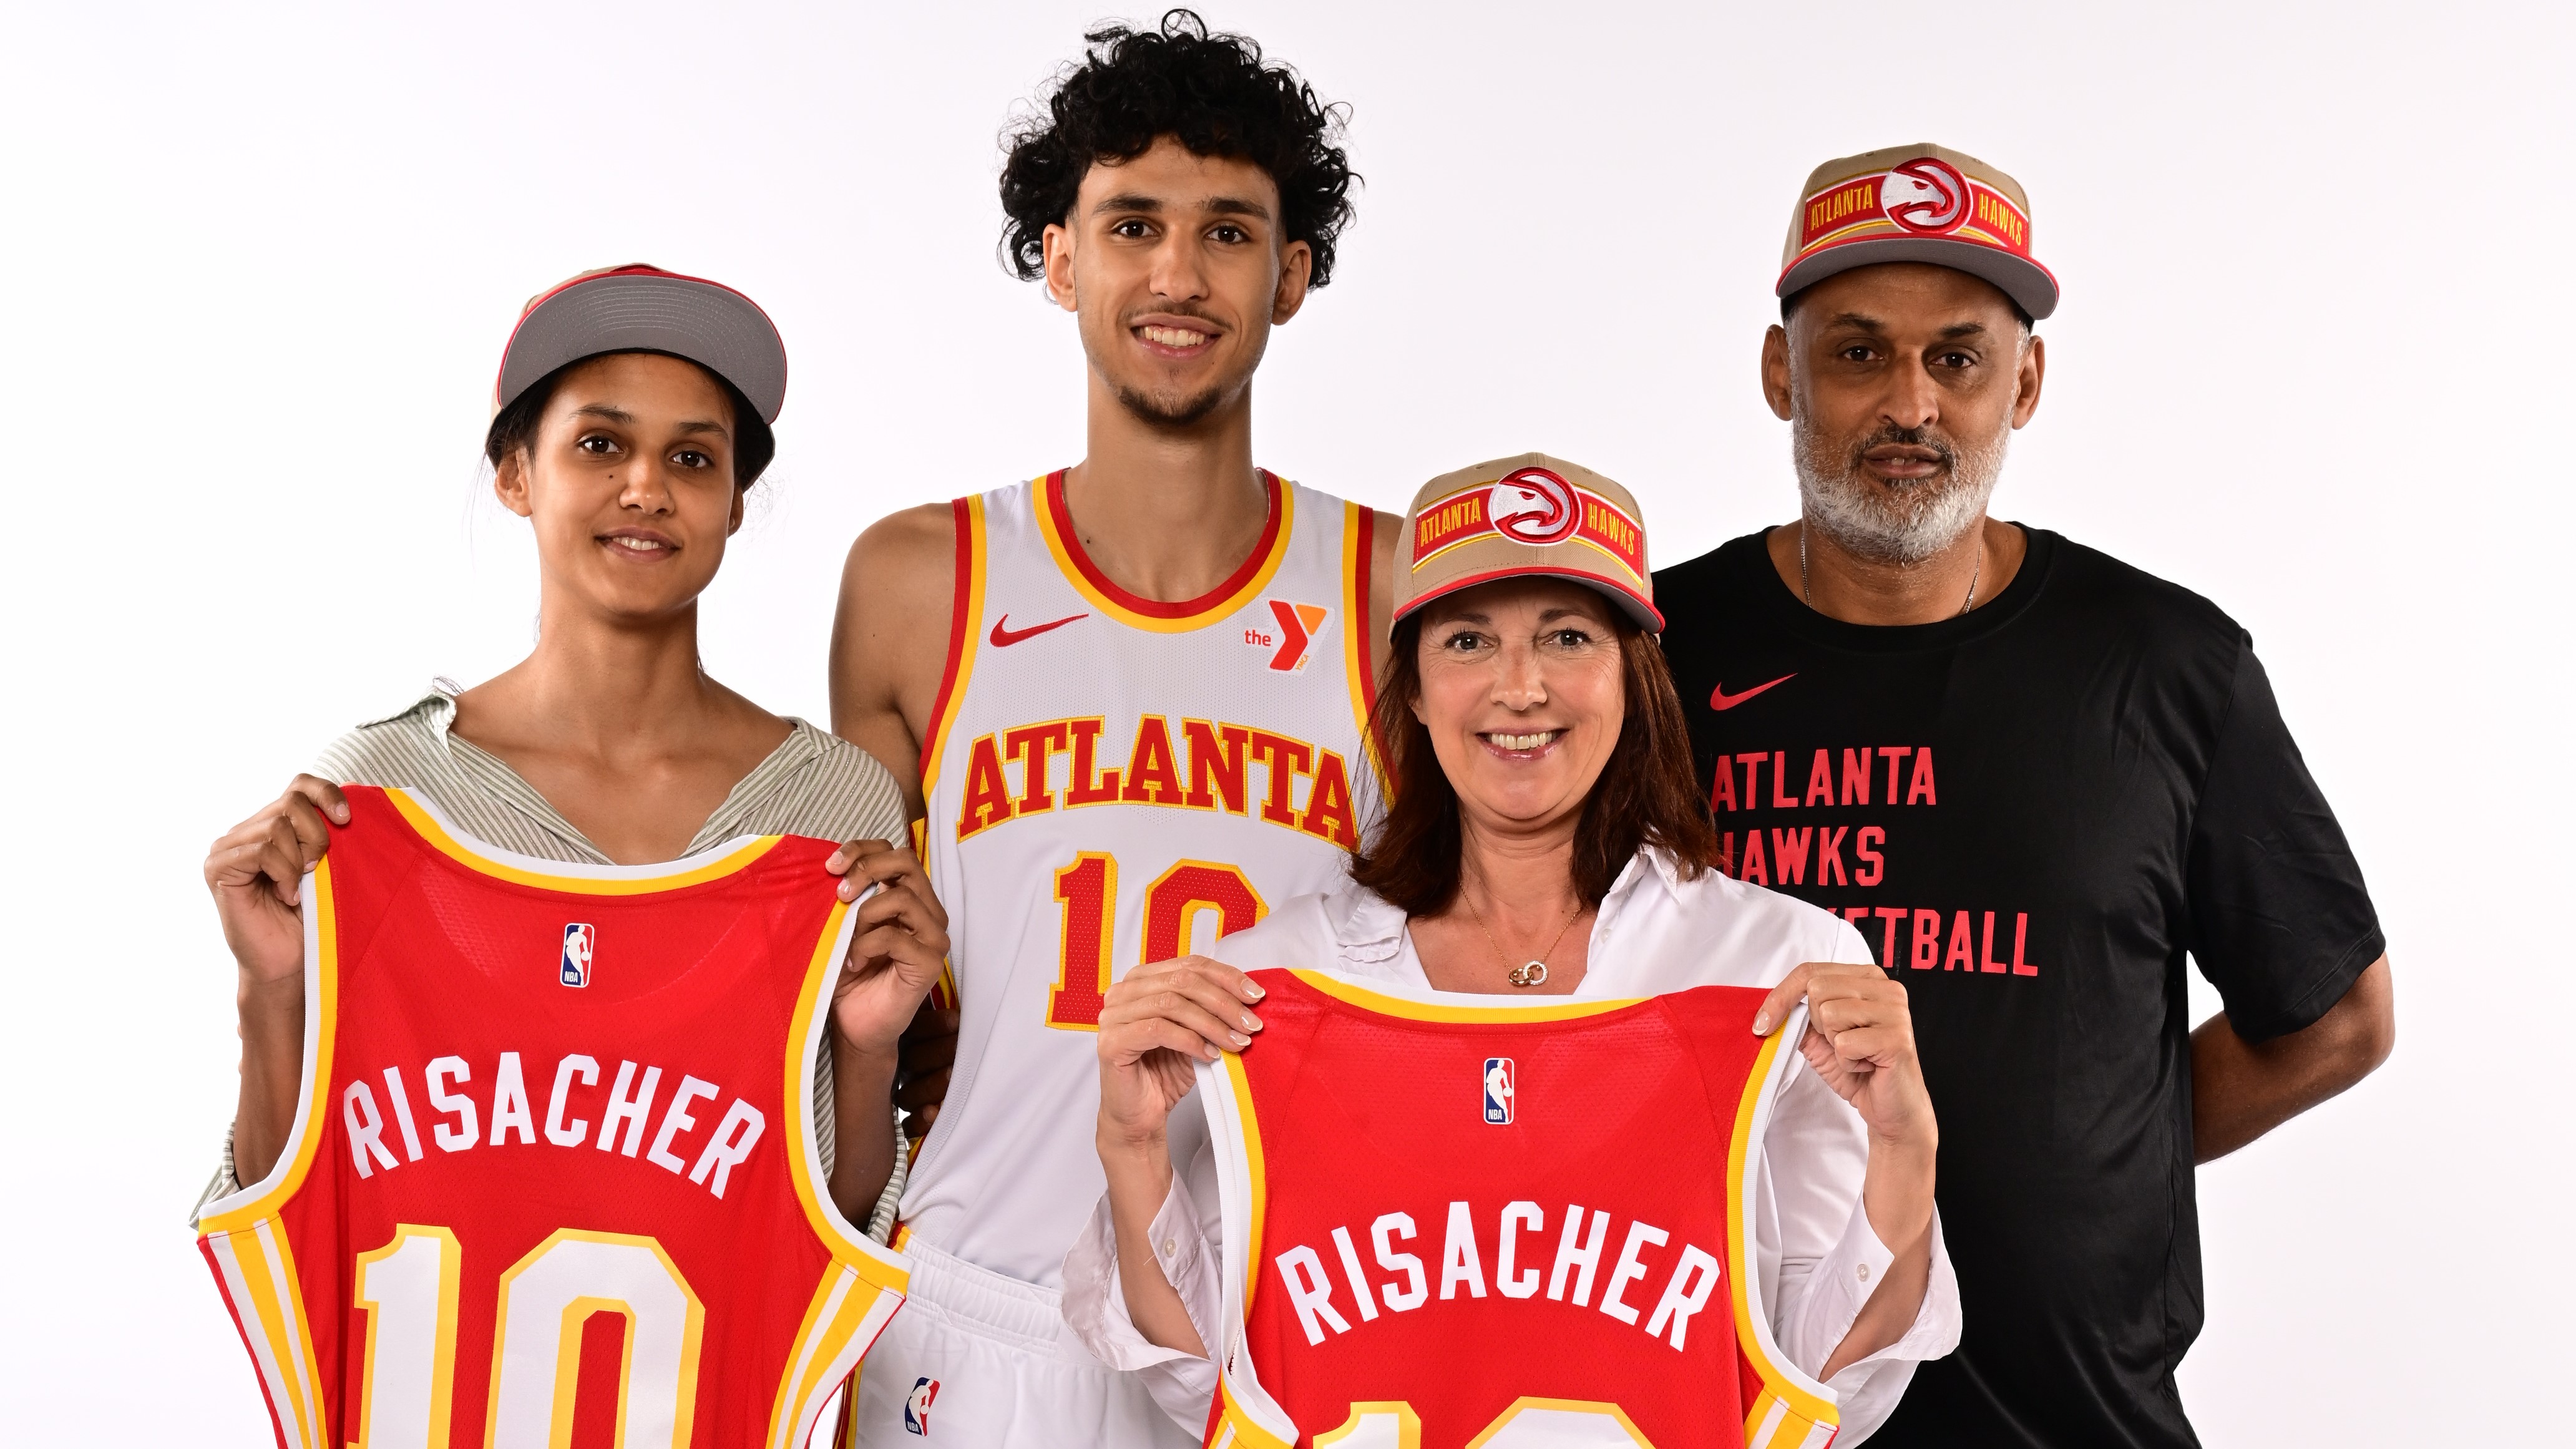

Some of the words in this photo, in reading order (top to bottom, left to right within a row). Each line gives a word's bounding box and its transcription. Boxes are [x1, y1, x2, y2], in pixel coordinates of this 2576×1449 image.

[1810, 183, 1873, 231] ATLANTA
[1979, 192, 2023, 246] HAWKS
[1420, 497, 1482, 548] ATLANTA
[1588, 502, 1635, 556] HAWKS
[1244, 629, 1271, 646] the
[1295, 654, 1309, 671] YMCA
[956, 713, 1361, 853] ATLANTA
[1709, 746, 1936, 812] ATLANTA
[564, 970, 578, 983] NBA
[343, 1051, 766, 1199] RISACHER
[1488, 1109, 1503, 1120] NBA
[1275, 1201, 1720, 1353] RISACHER
[346, 1223, 706, 1449] 10
[907, 1421, 919, 1433] NBA
